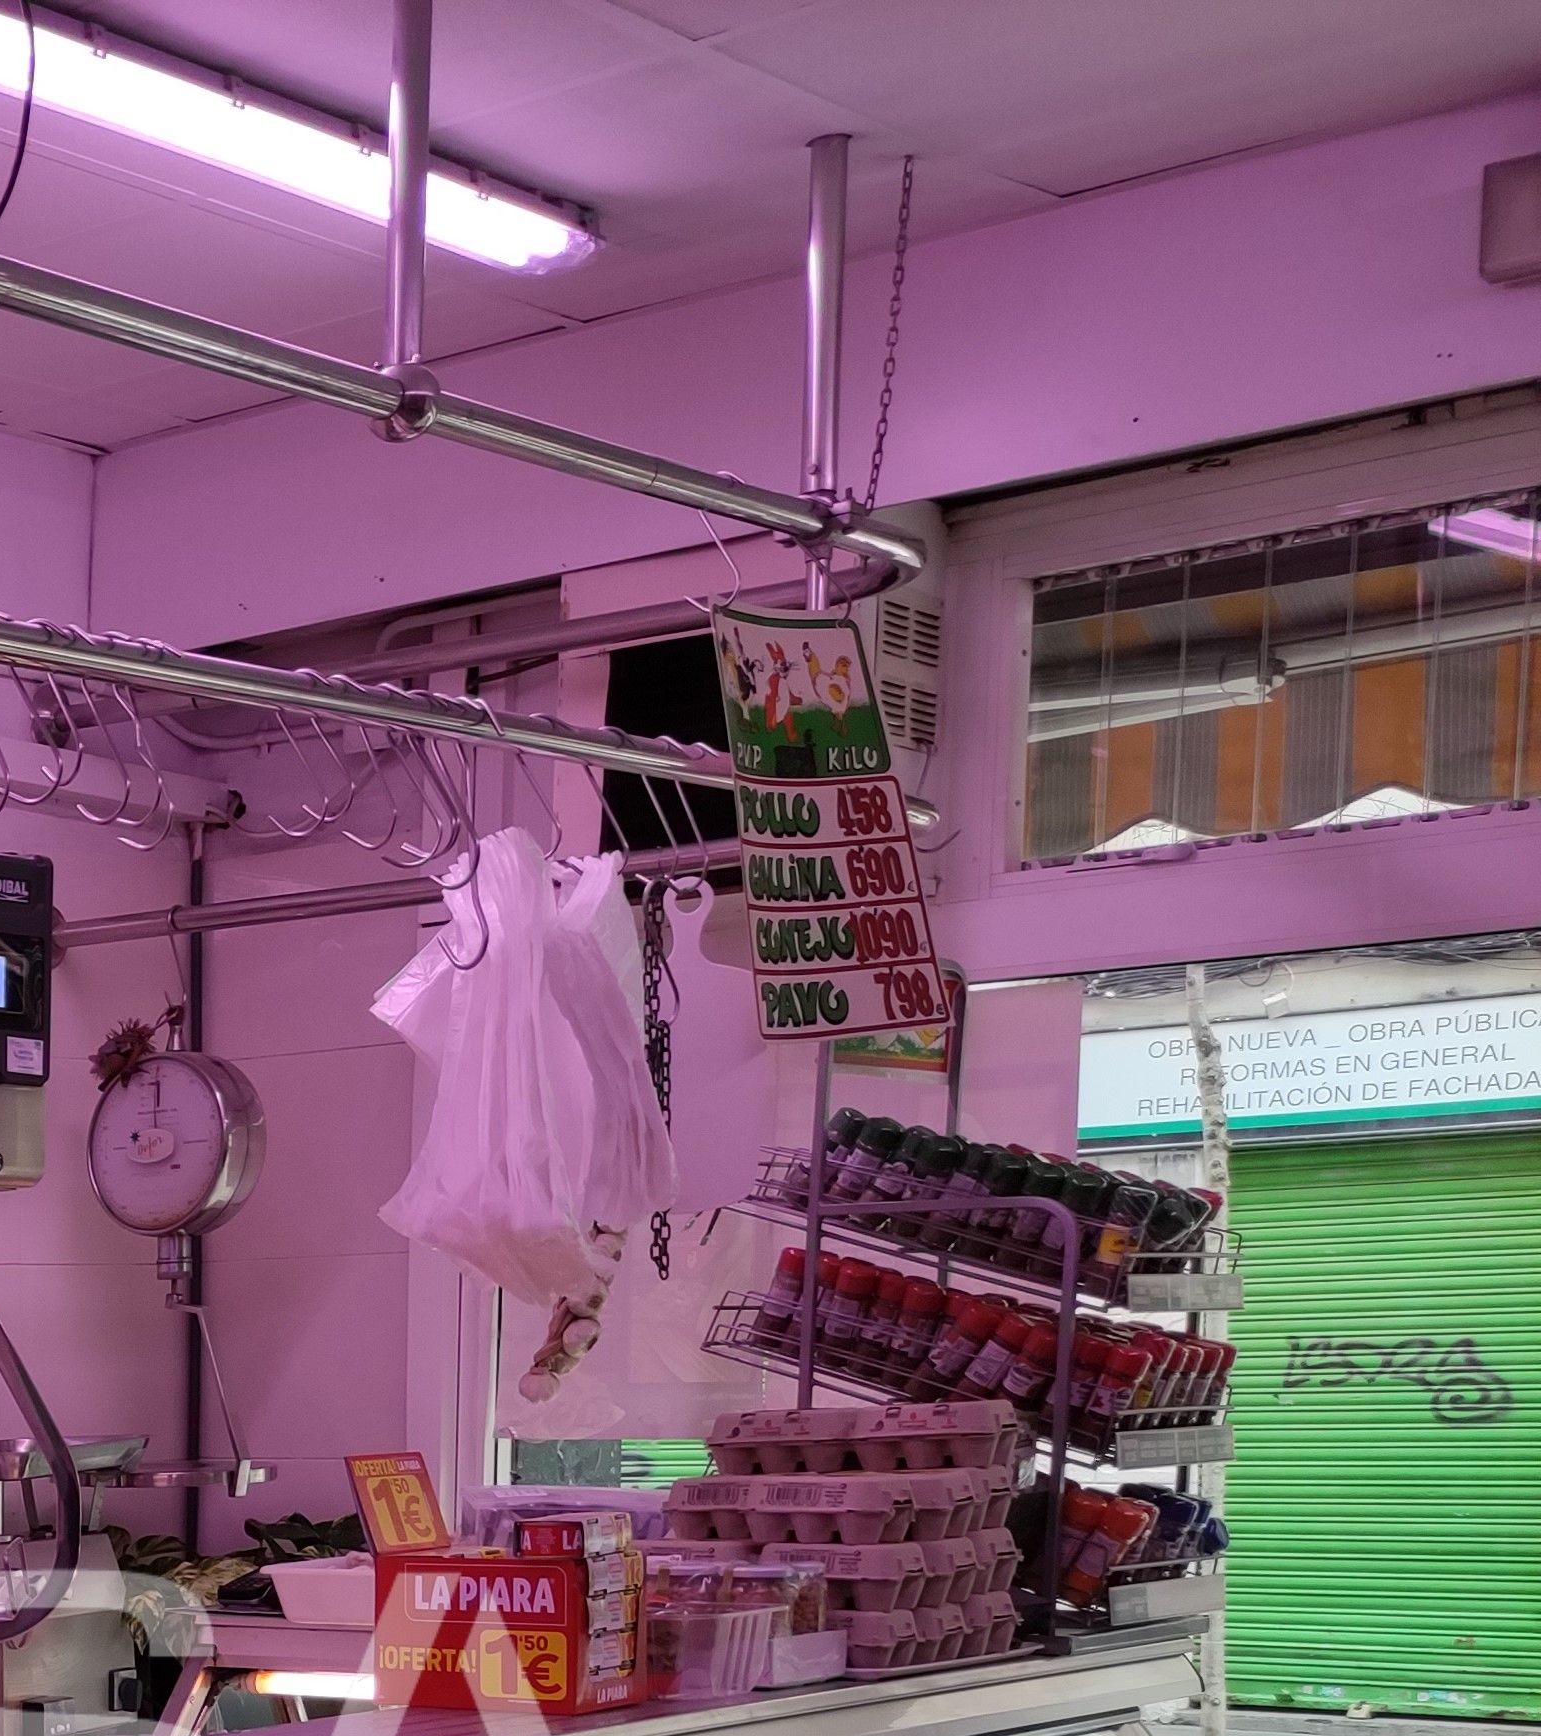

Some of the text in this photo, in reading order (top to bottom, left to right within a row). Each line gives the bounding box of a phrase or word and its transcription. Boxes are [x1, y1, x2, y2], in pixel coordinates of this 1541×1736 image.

[739, 785, 820, 838] POLLO
[761, 980, 849, 1028] PAVO
[1227, 1027, 1317, 1053] NUEVA
[1347, 1018, 1426, 1043] OBRA
[1435, 1008, 1541, 1035] PÚBLIC
[1179, 1042, 1516, 1086] RFORMAS EN GENERAL
[1137, 1081, 1352, 1117] REHAILITACIÓN
[1361, 1080, 1398, 1100] DE
[351, 1459, 396, 1477] ¡OFERTA!
[415, 1575, 555, 1613] LA PIARA
[379, 1646, 477, 1675] ¡OFERTA!
